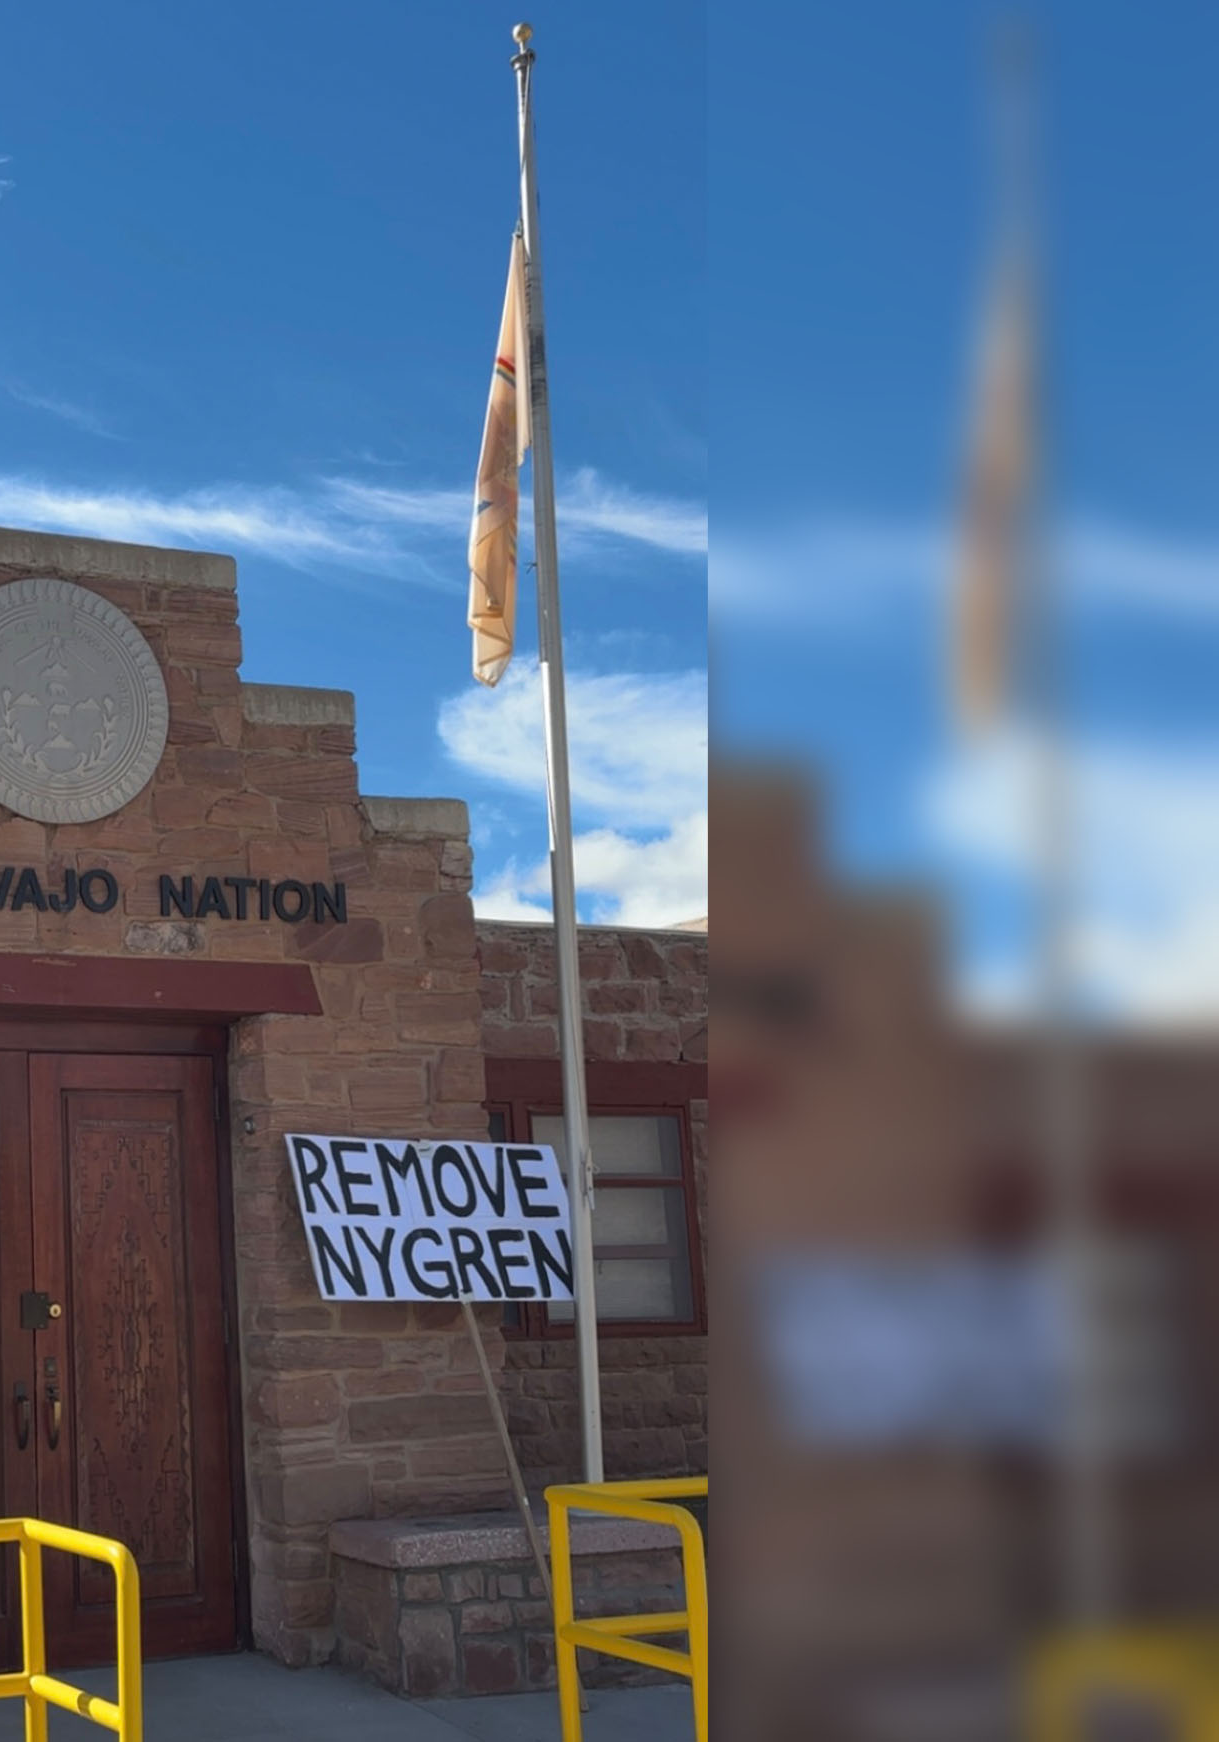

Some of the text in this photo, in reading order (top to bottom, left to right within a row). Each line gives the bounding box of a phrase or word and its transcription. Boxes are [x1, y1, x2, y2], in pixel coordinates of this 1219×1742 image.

[159, 874, 348, 925] NATION
[291, 1136, 561, 1218] REMOVE
[310, 1225, 574, 1299] NYGREN
